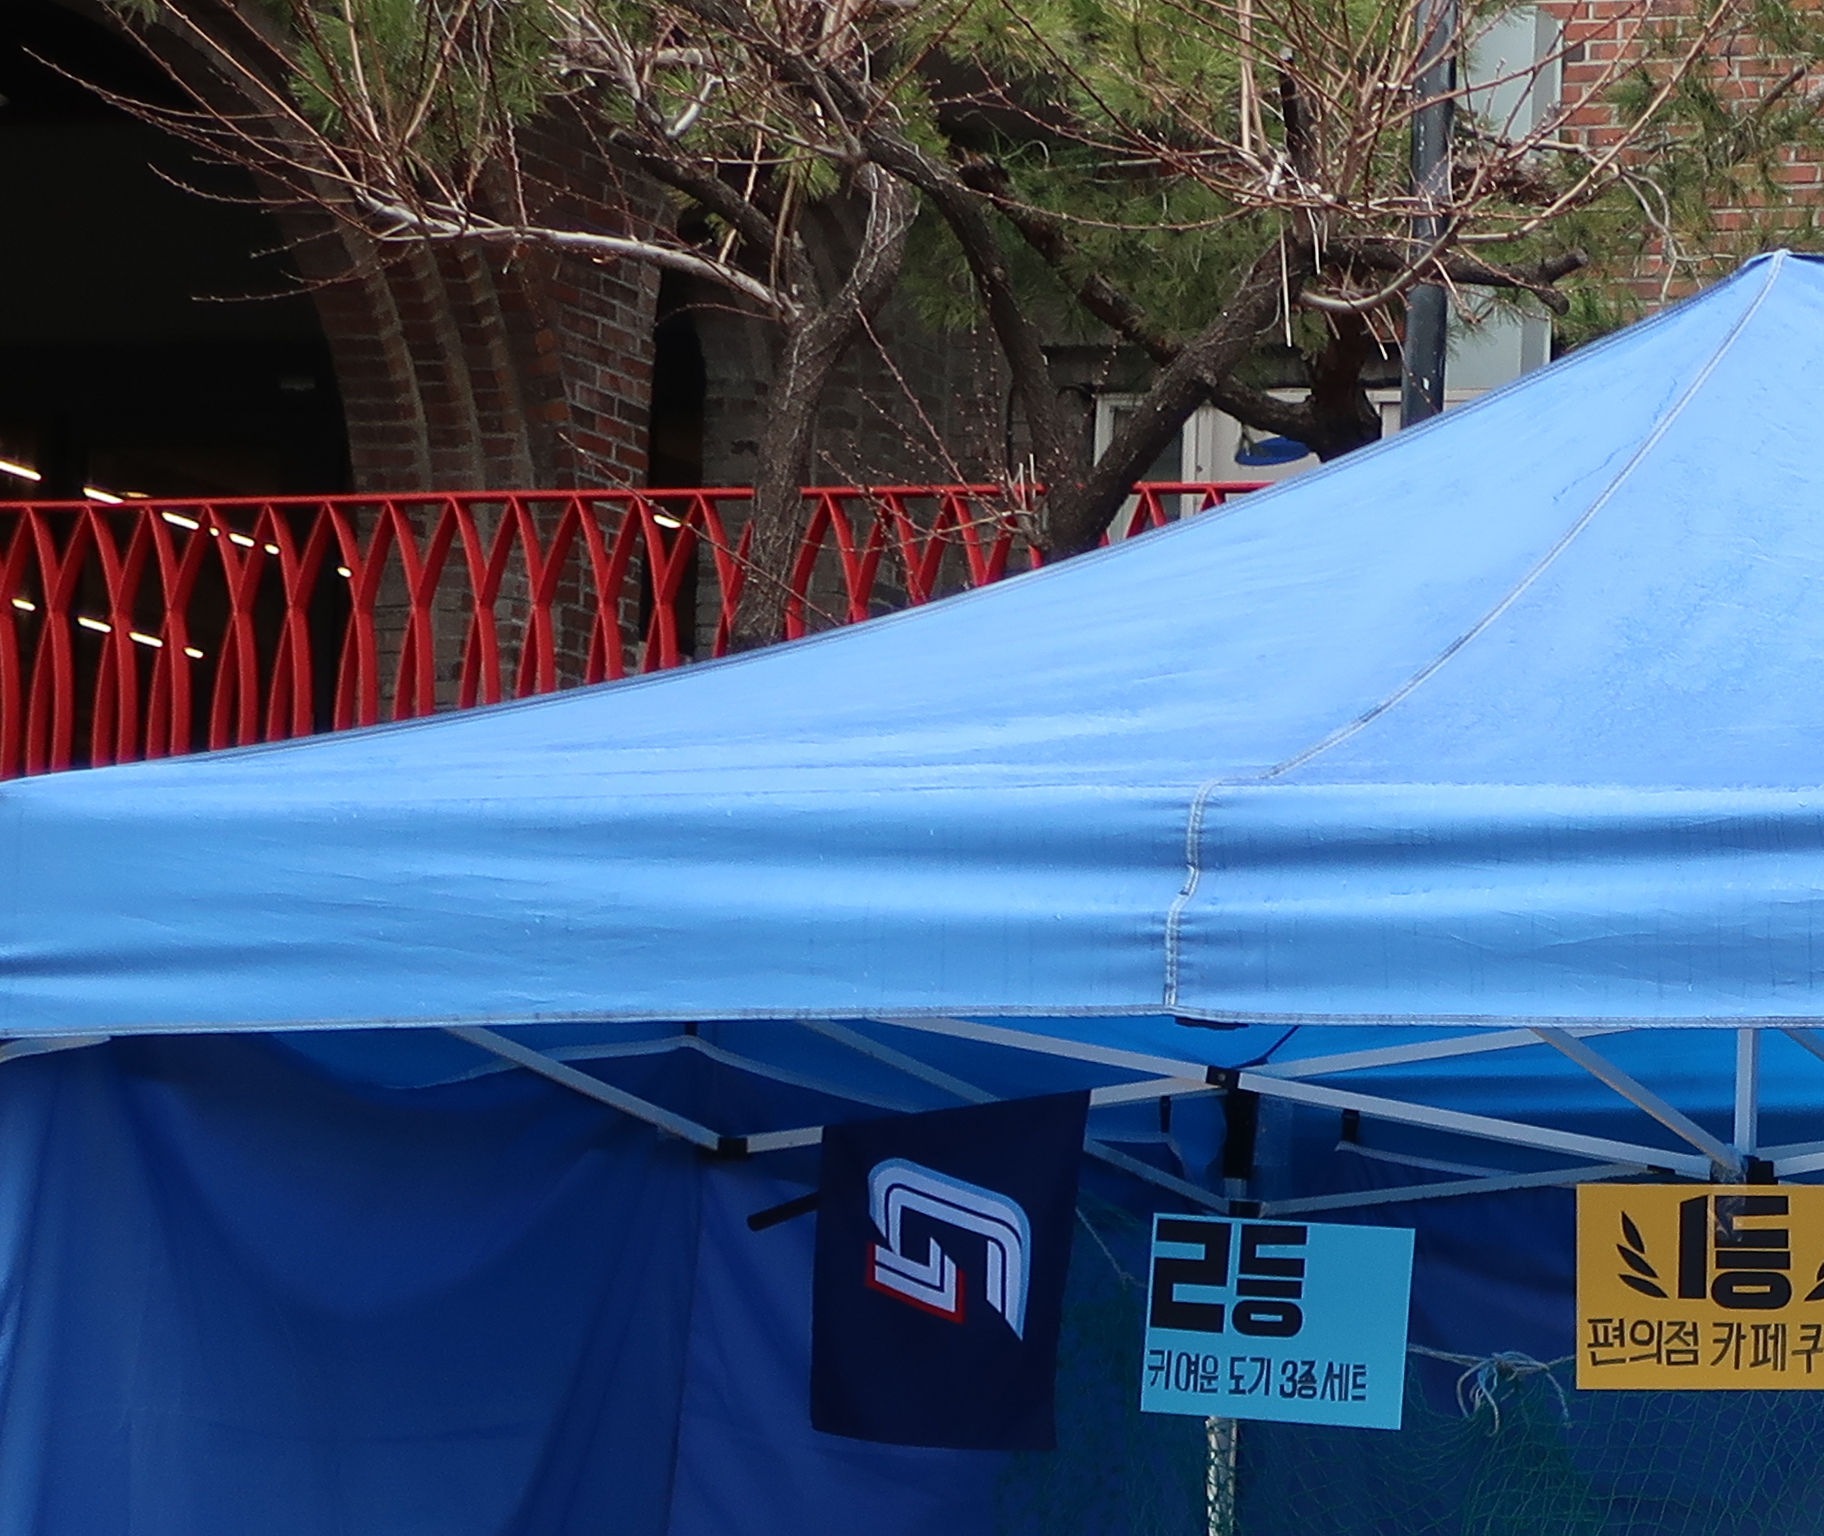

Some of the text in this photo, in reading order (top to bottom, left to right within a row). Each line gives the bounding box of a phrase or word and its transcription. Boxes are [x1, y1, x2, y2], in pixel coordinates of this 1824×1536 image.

[1150, 1219, 1308, 1338] 2등
[1678, 1194, 1792, 1310] 1등
[1147, 1350, 1219, 1393] 귀여운
[1228, 1356, 1272, 1396] 도기
[1587, 1318, 1699, 1366] 편의점
